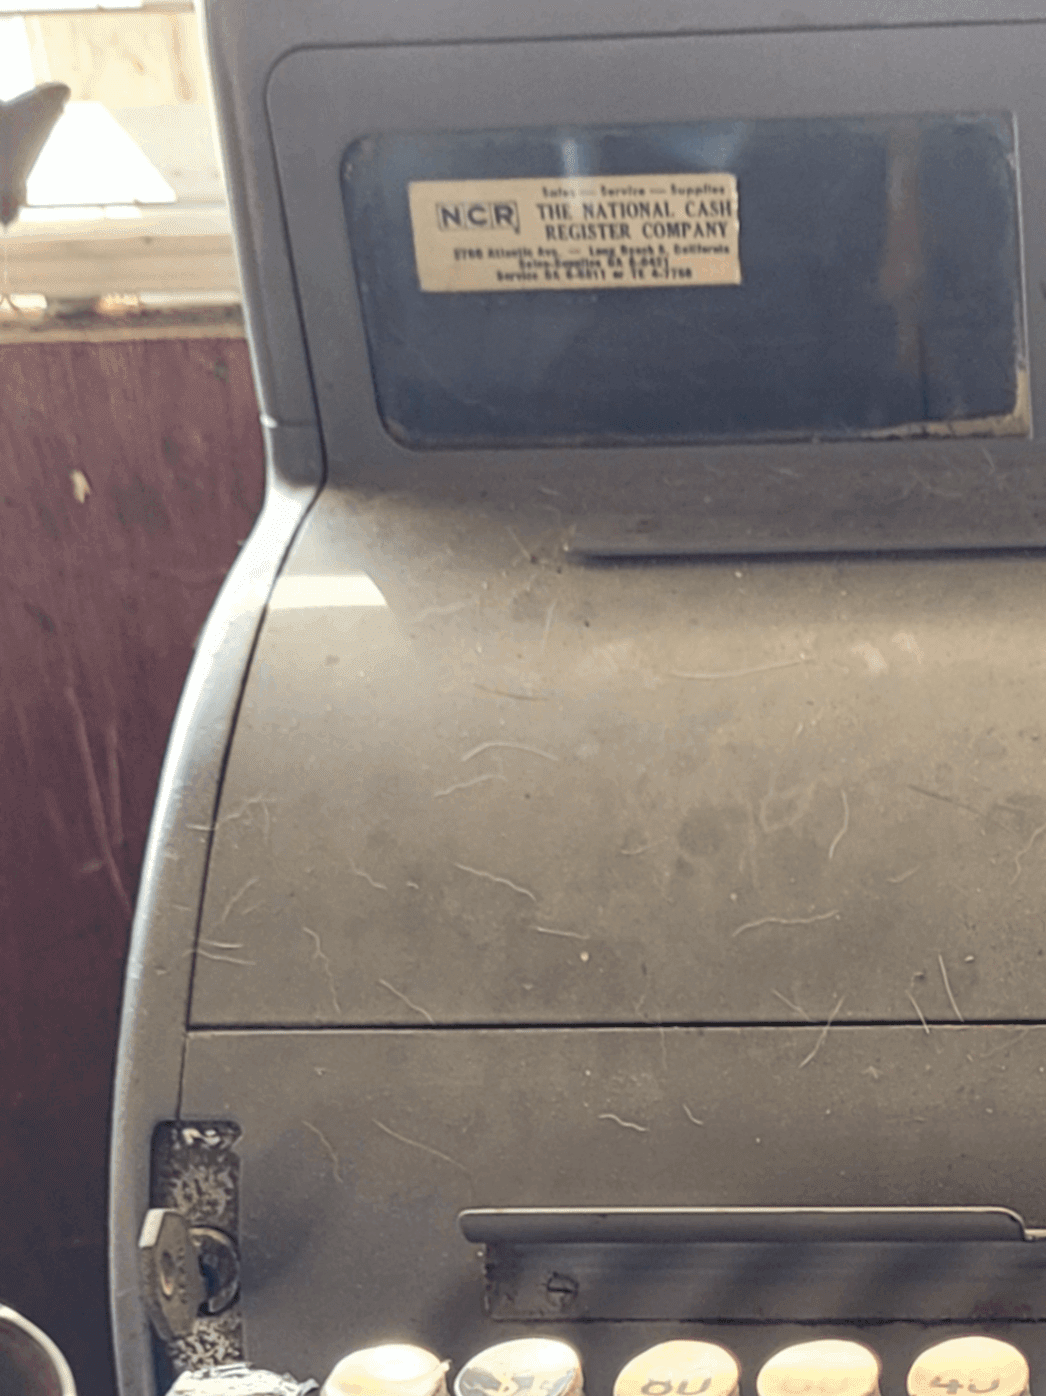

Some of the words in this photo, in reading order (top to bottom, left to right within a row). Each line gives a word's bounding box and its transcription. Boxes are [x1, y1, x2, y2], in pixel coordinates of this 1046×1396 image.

[600, 183, 646, 197] Service
[670, 182, 725, 197] Supplies
[440, 205, 515, 229] NCR
[536, 201, 572, 221] THE
[582, 199, 675, 220] NATIONAL
[684, 198, 732, 218] CASH
[545, 222, 632, 242] REGISTER
[640, 219, 728, 239] COMPANY
